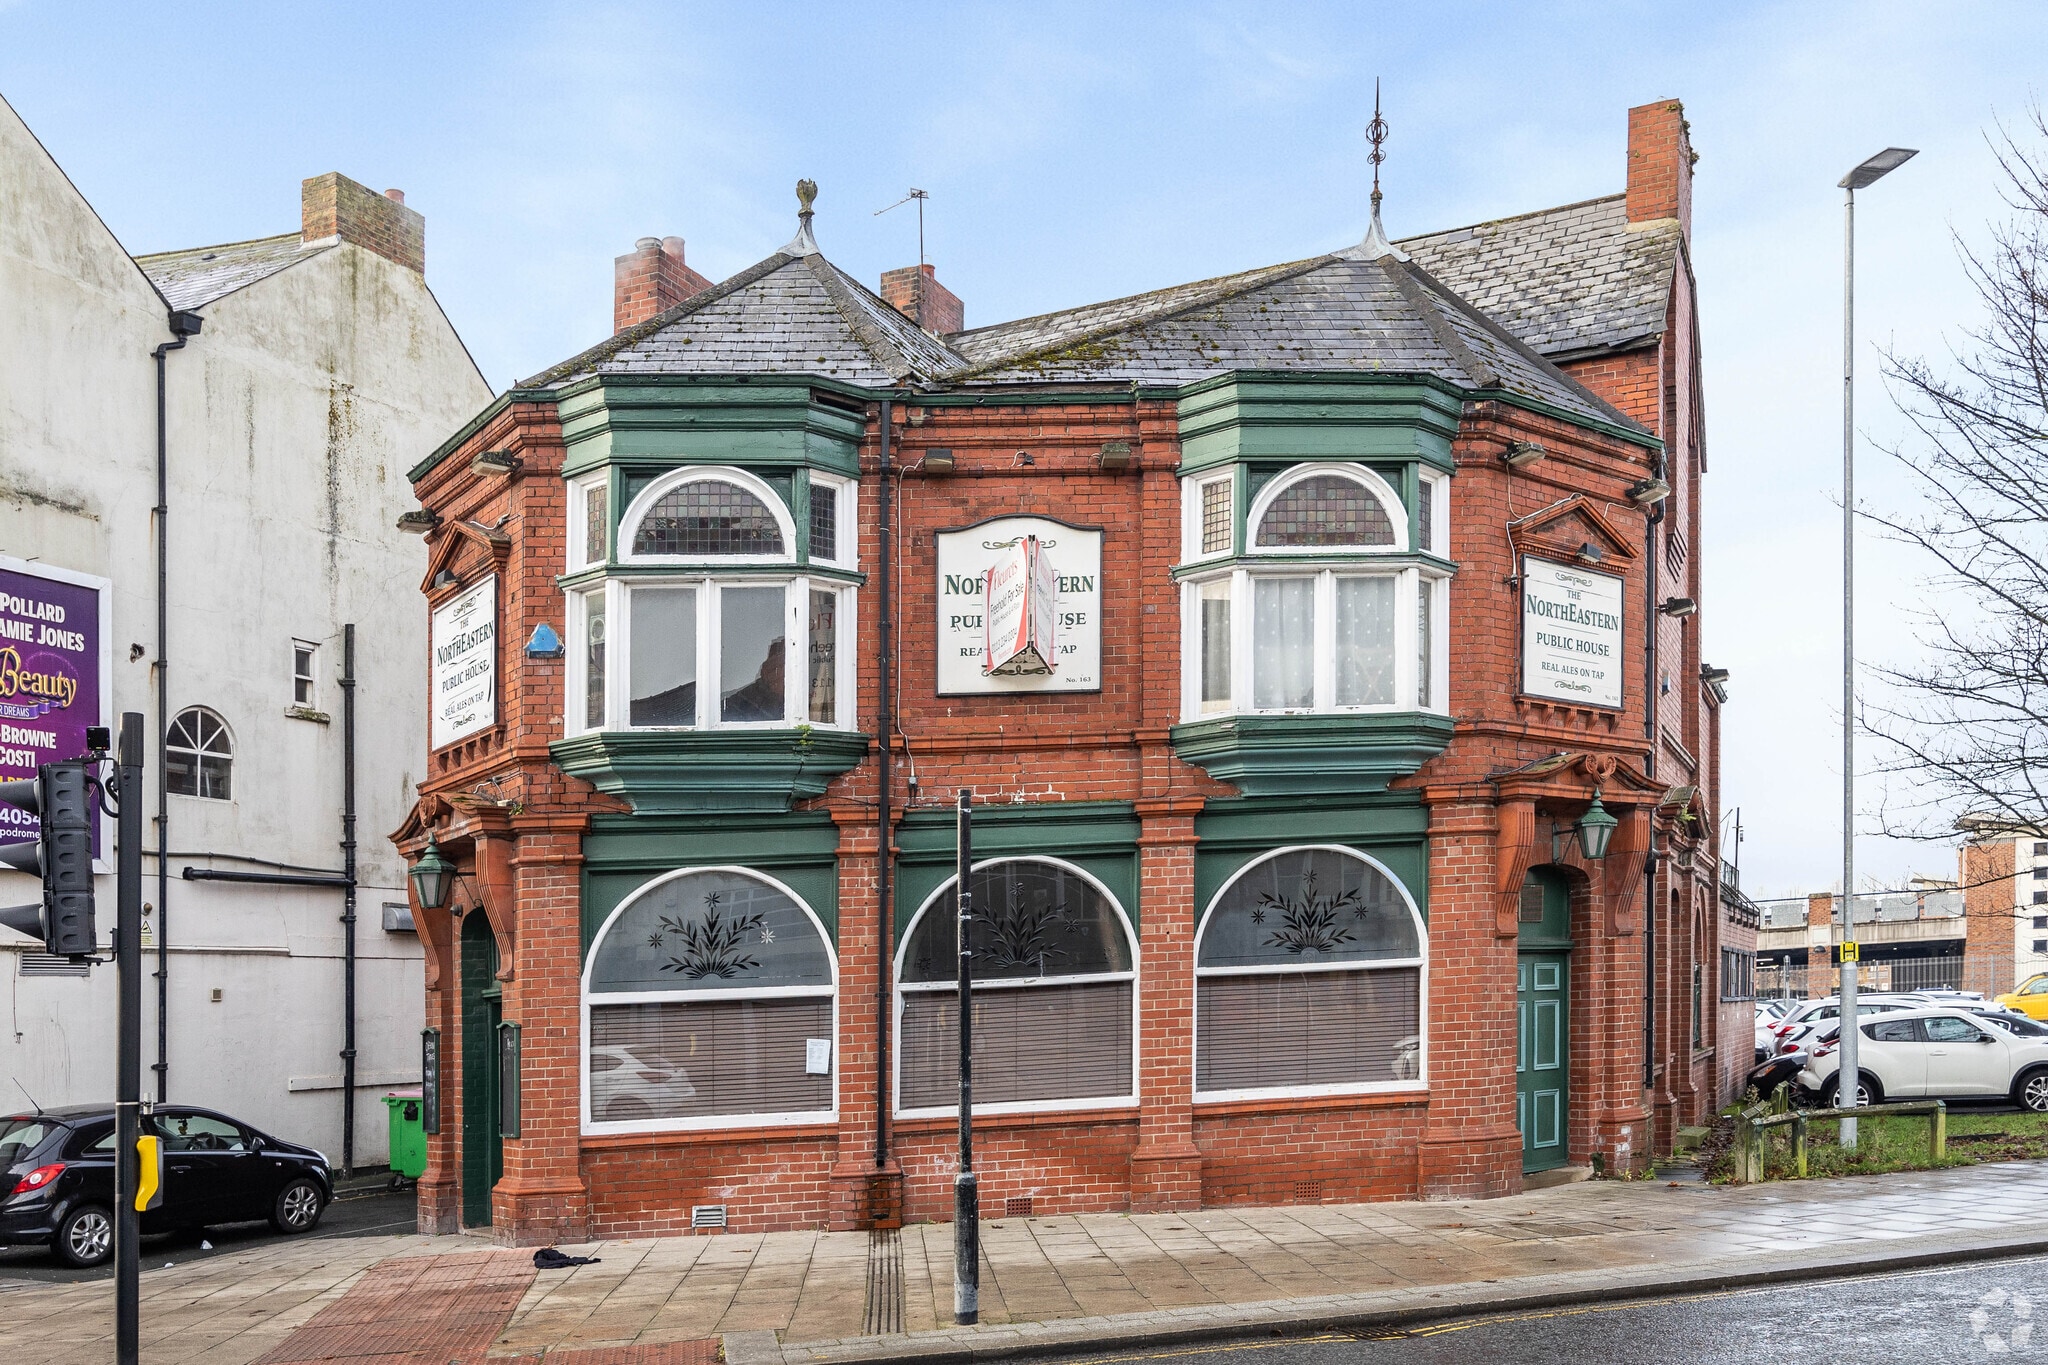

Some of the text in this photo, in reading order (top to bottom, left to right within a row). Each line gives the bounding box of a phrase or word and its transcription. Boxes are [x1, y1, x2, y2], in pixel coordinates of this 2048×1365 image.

[0, 592, 66, 623] POLLARD
[1567, 590, 1581, 600] THE
[460, 617, 469, 629] THE
[37, 624, 85, 652] JONES
[1536, 632, 1610, 656] PUBLIC HOUSE
[0, 645, 77, 707] Beauty
[442, 659, 488, 693] PUBLIC HOUSE
[1541, 661, 1605, 680] REAL ALES ON TAP
[4, 705, 30, 718] DREAMS
[0, 724, 57, 750] BROWNE
